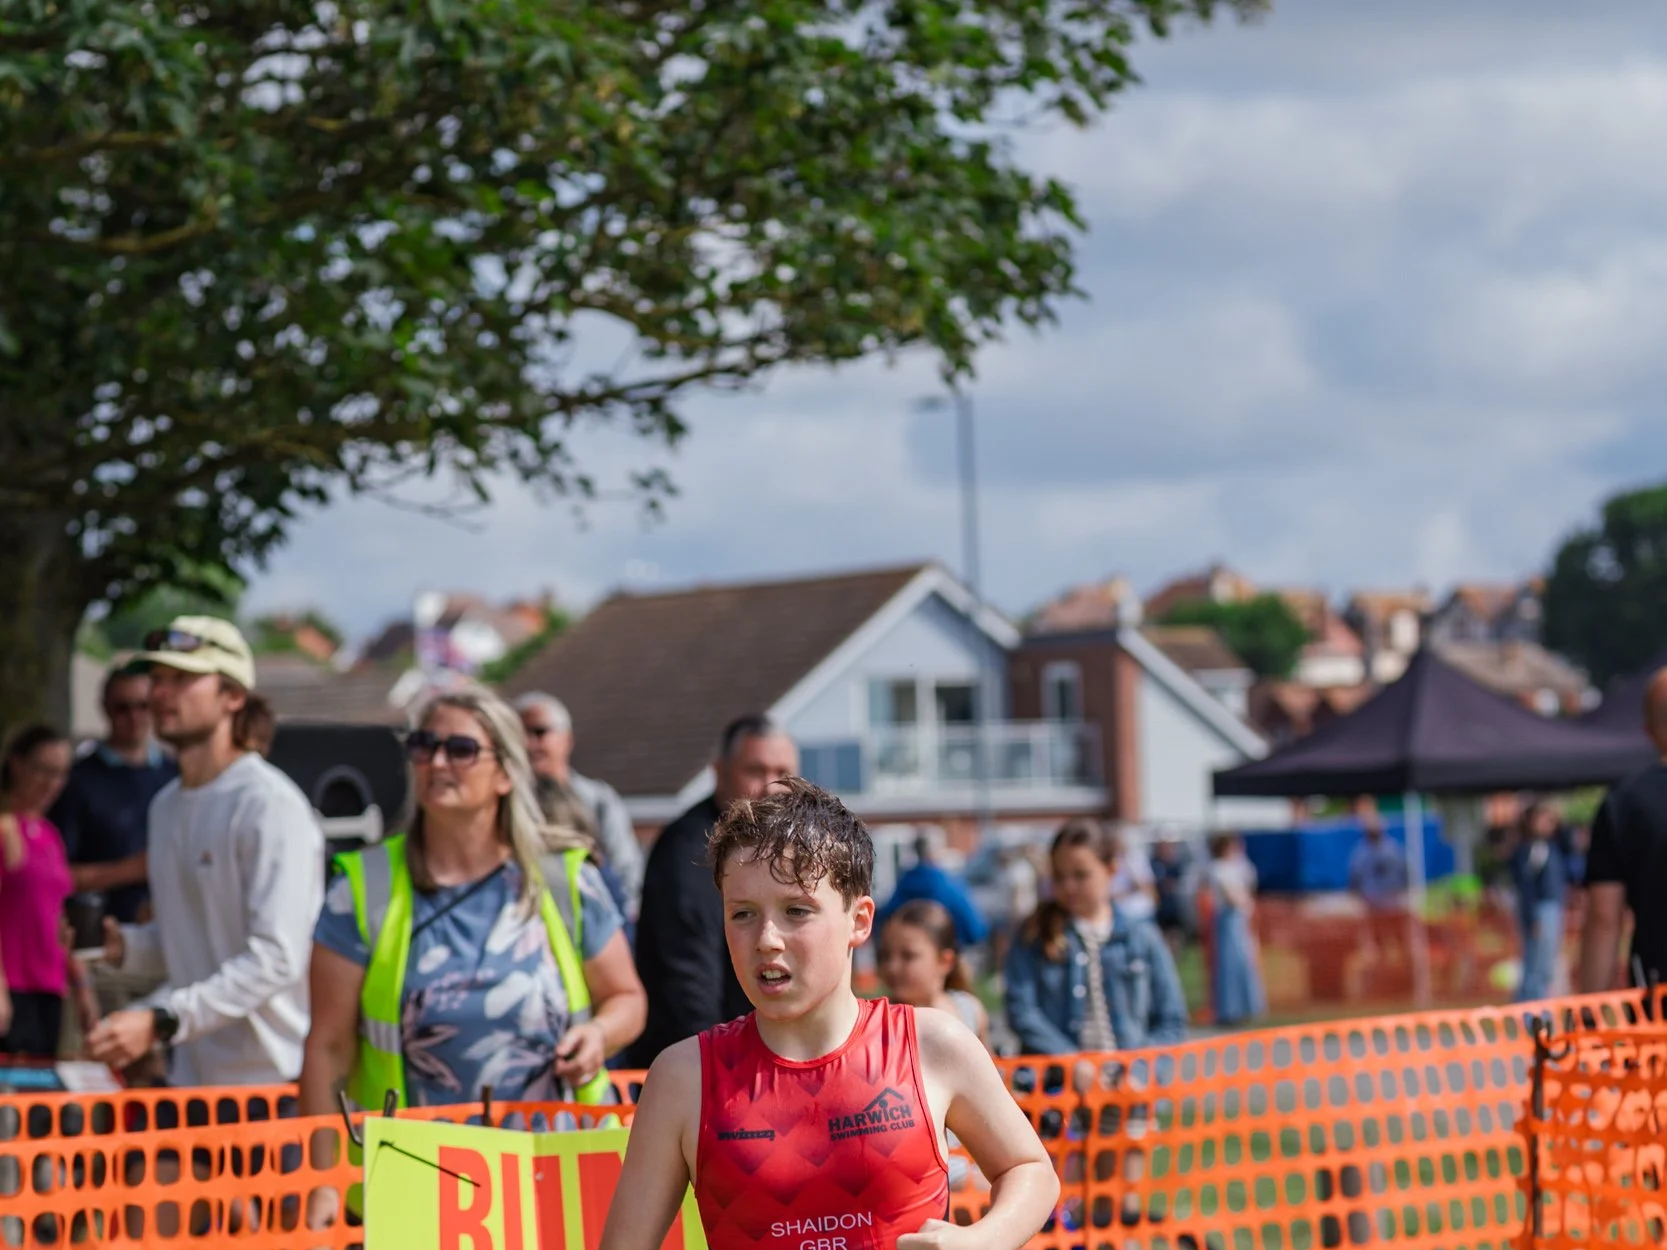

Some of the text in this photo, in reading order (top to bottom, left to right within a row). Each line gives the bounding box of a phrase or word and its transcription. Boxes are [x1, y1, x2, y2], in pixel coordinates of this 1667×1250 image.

[827, 1101, 912, 1131] HARWICH
[830, 1119, 915, 1141] SWIMMING CLUB
[771, 1211, 872, 1237] SHAIDON
